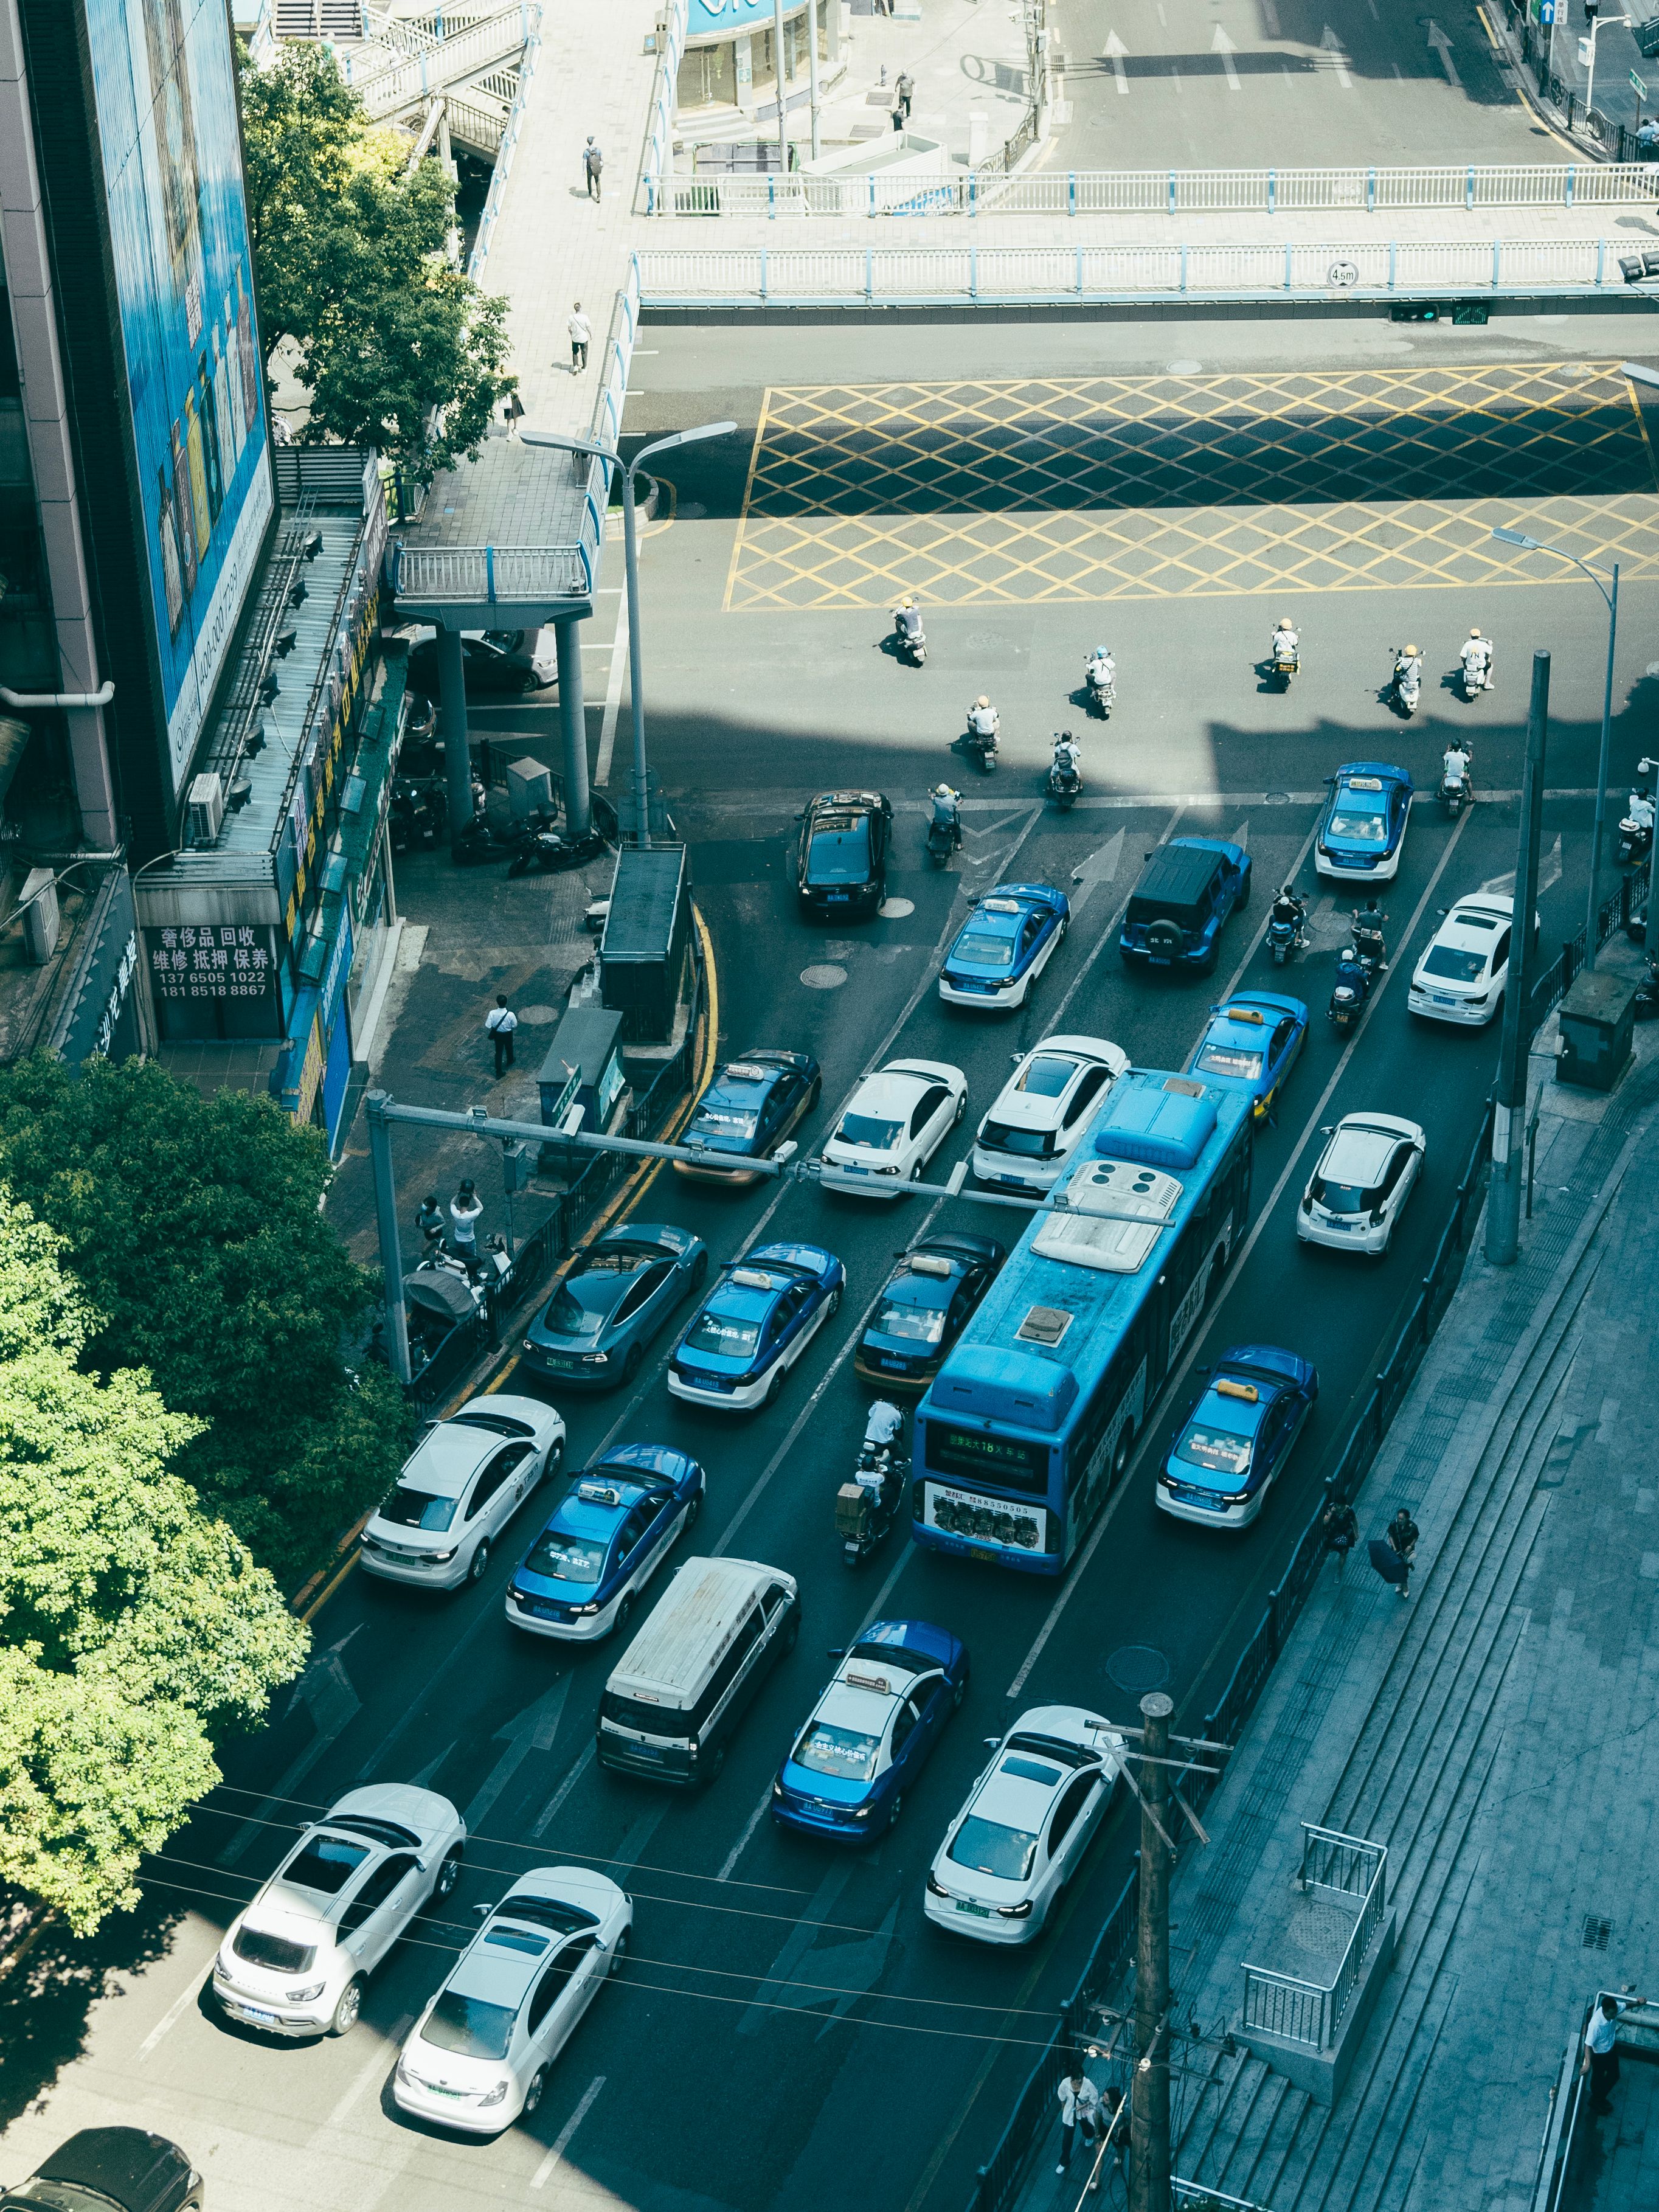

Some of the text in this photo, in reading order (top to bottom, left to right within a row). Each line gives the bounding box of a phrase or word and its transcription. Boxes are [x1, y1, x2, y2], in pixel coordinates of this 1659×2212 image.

[1332, 269, 1354, 280] 4.5m
[161, 926, 255, 948] 奢侈品 回收
[153, 948, 268, 971] 维修 抵押 保养
[159, 972, 266, 983] 137 6505 1022
[161, 985, 266, 997] 181 8518 8867
[982, 1441, 994, 1453] 18
[977, 1498, 1028, 1514] 88550505
[975, 1533, 992, 1542] 3835
